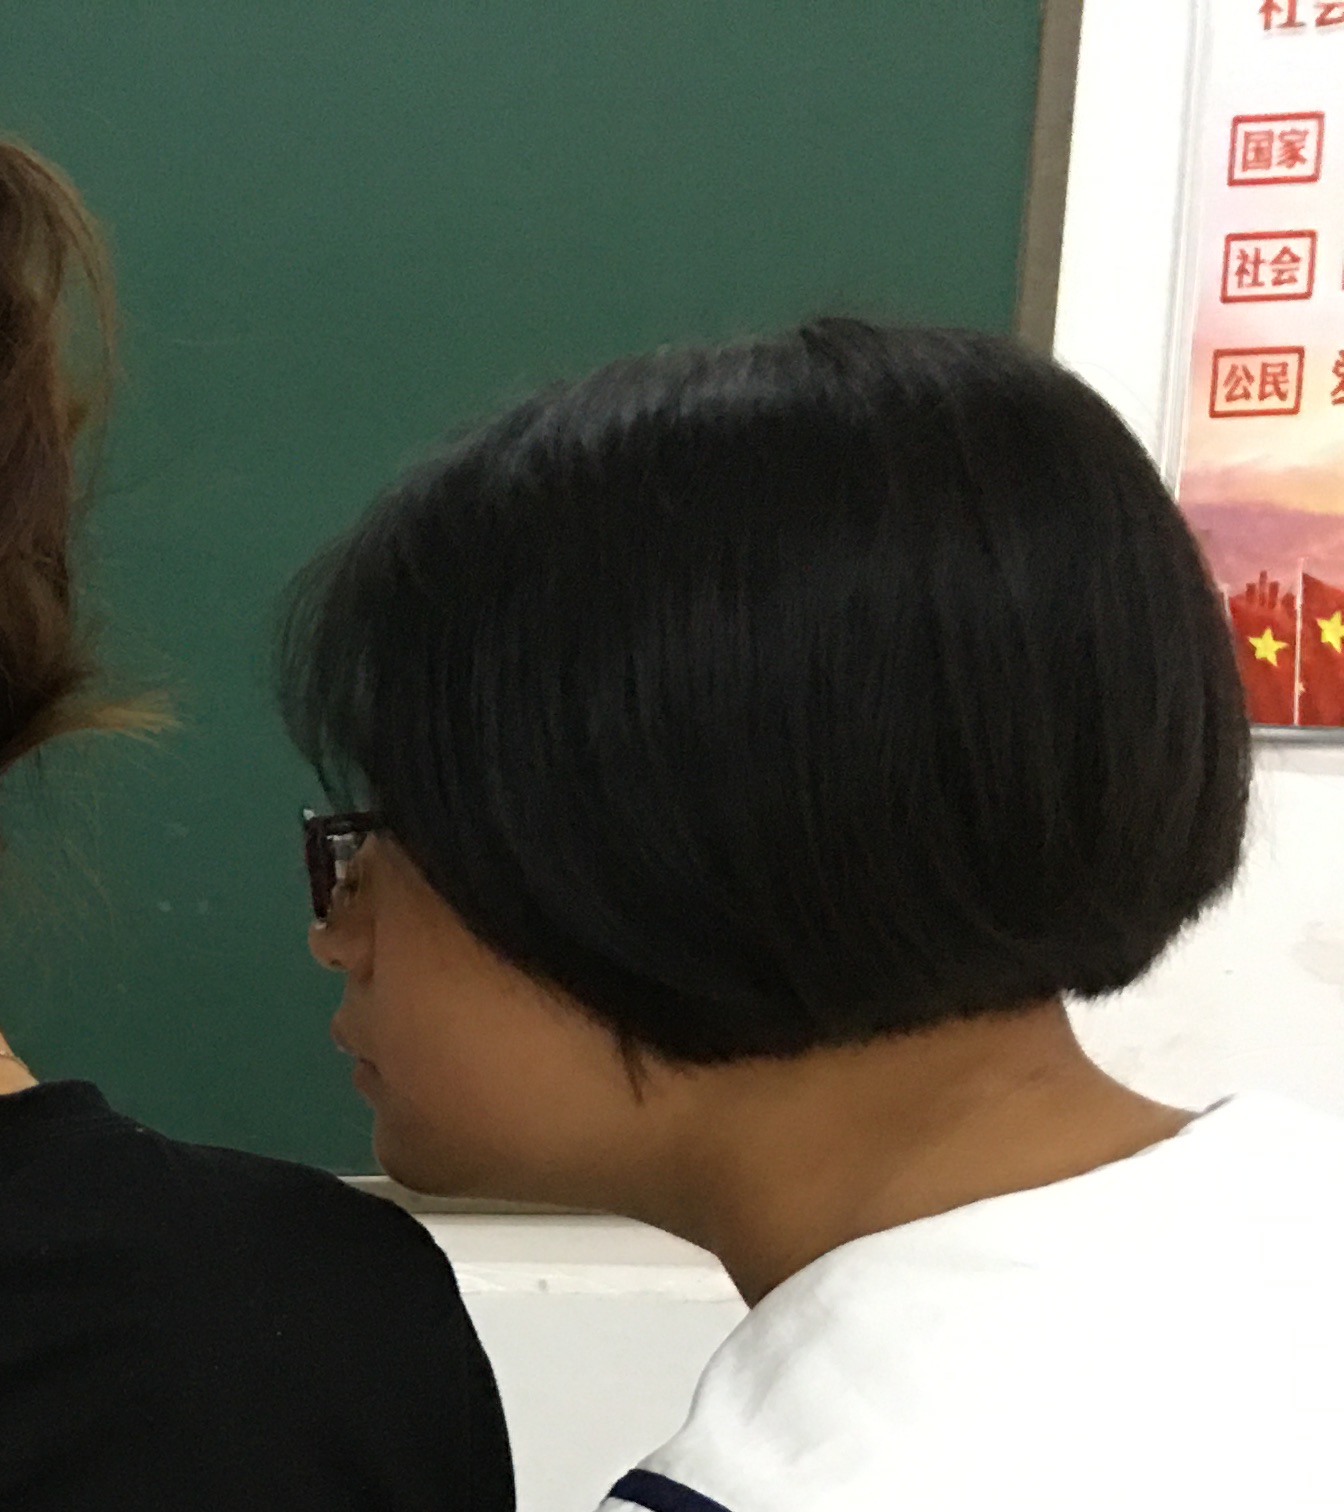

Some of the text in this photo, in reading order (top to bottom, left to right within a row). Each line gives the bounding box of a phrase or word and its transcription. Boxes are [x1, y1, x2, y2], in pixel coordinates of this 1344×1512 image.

[1242, 129, 1309, 172] 国家
[1235, 245, 1301, 288] 社会
[1223, 361, 1289, 402] 公民
